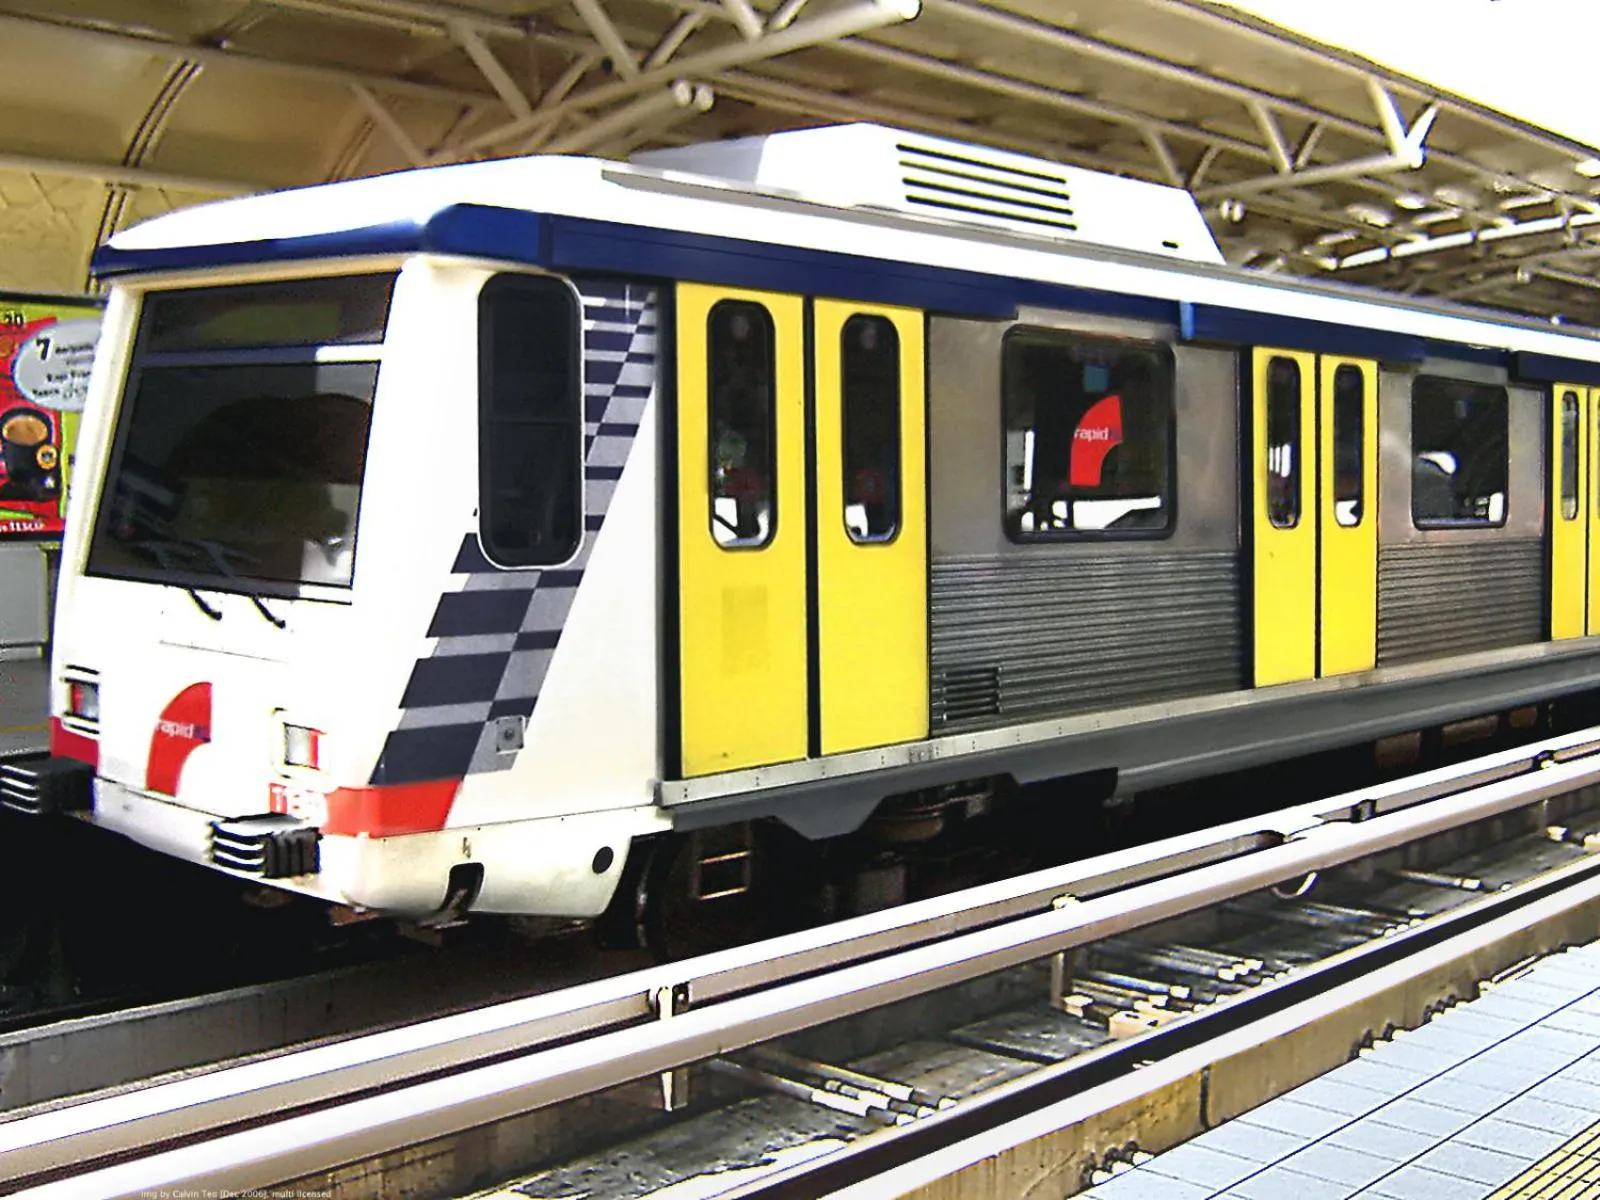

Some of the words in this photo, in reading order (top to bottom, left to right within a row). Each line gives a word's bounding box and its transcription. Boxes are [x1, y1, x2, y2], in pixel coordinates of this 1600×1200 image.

[36, 337, 50, 361] 7
[1073, 426, 1109, 442] rapid
[155, 720, 194, 739] rapid
